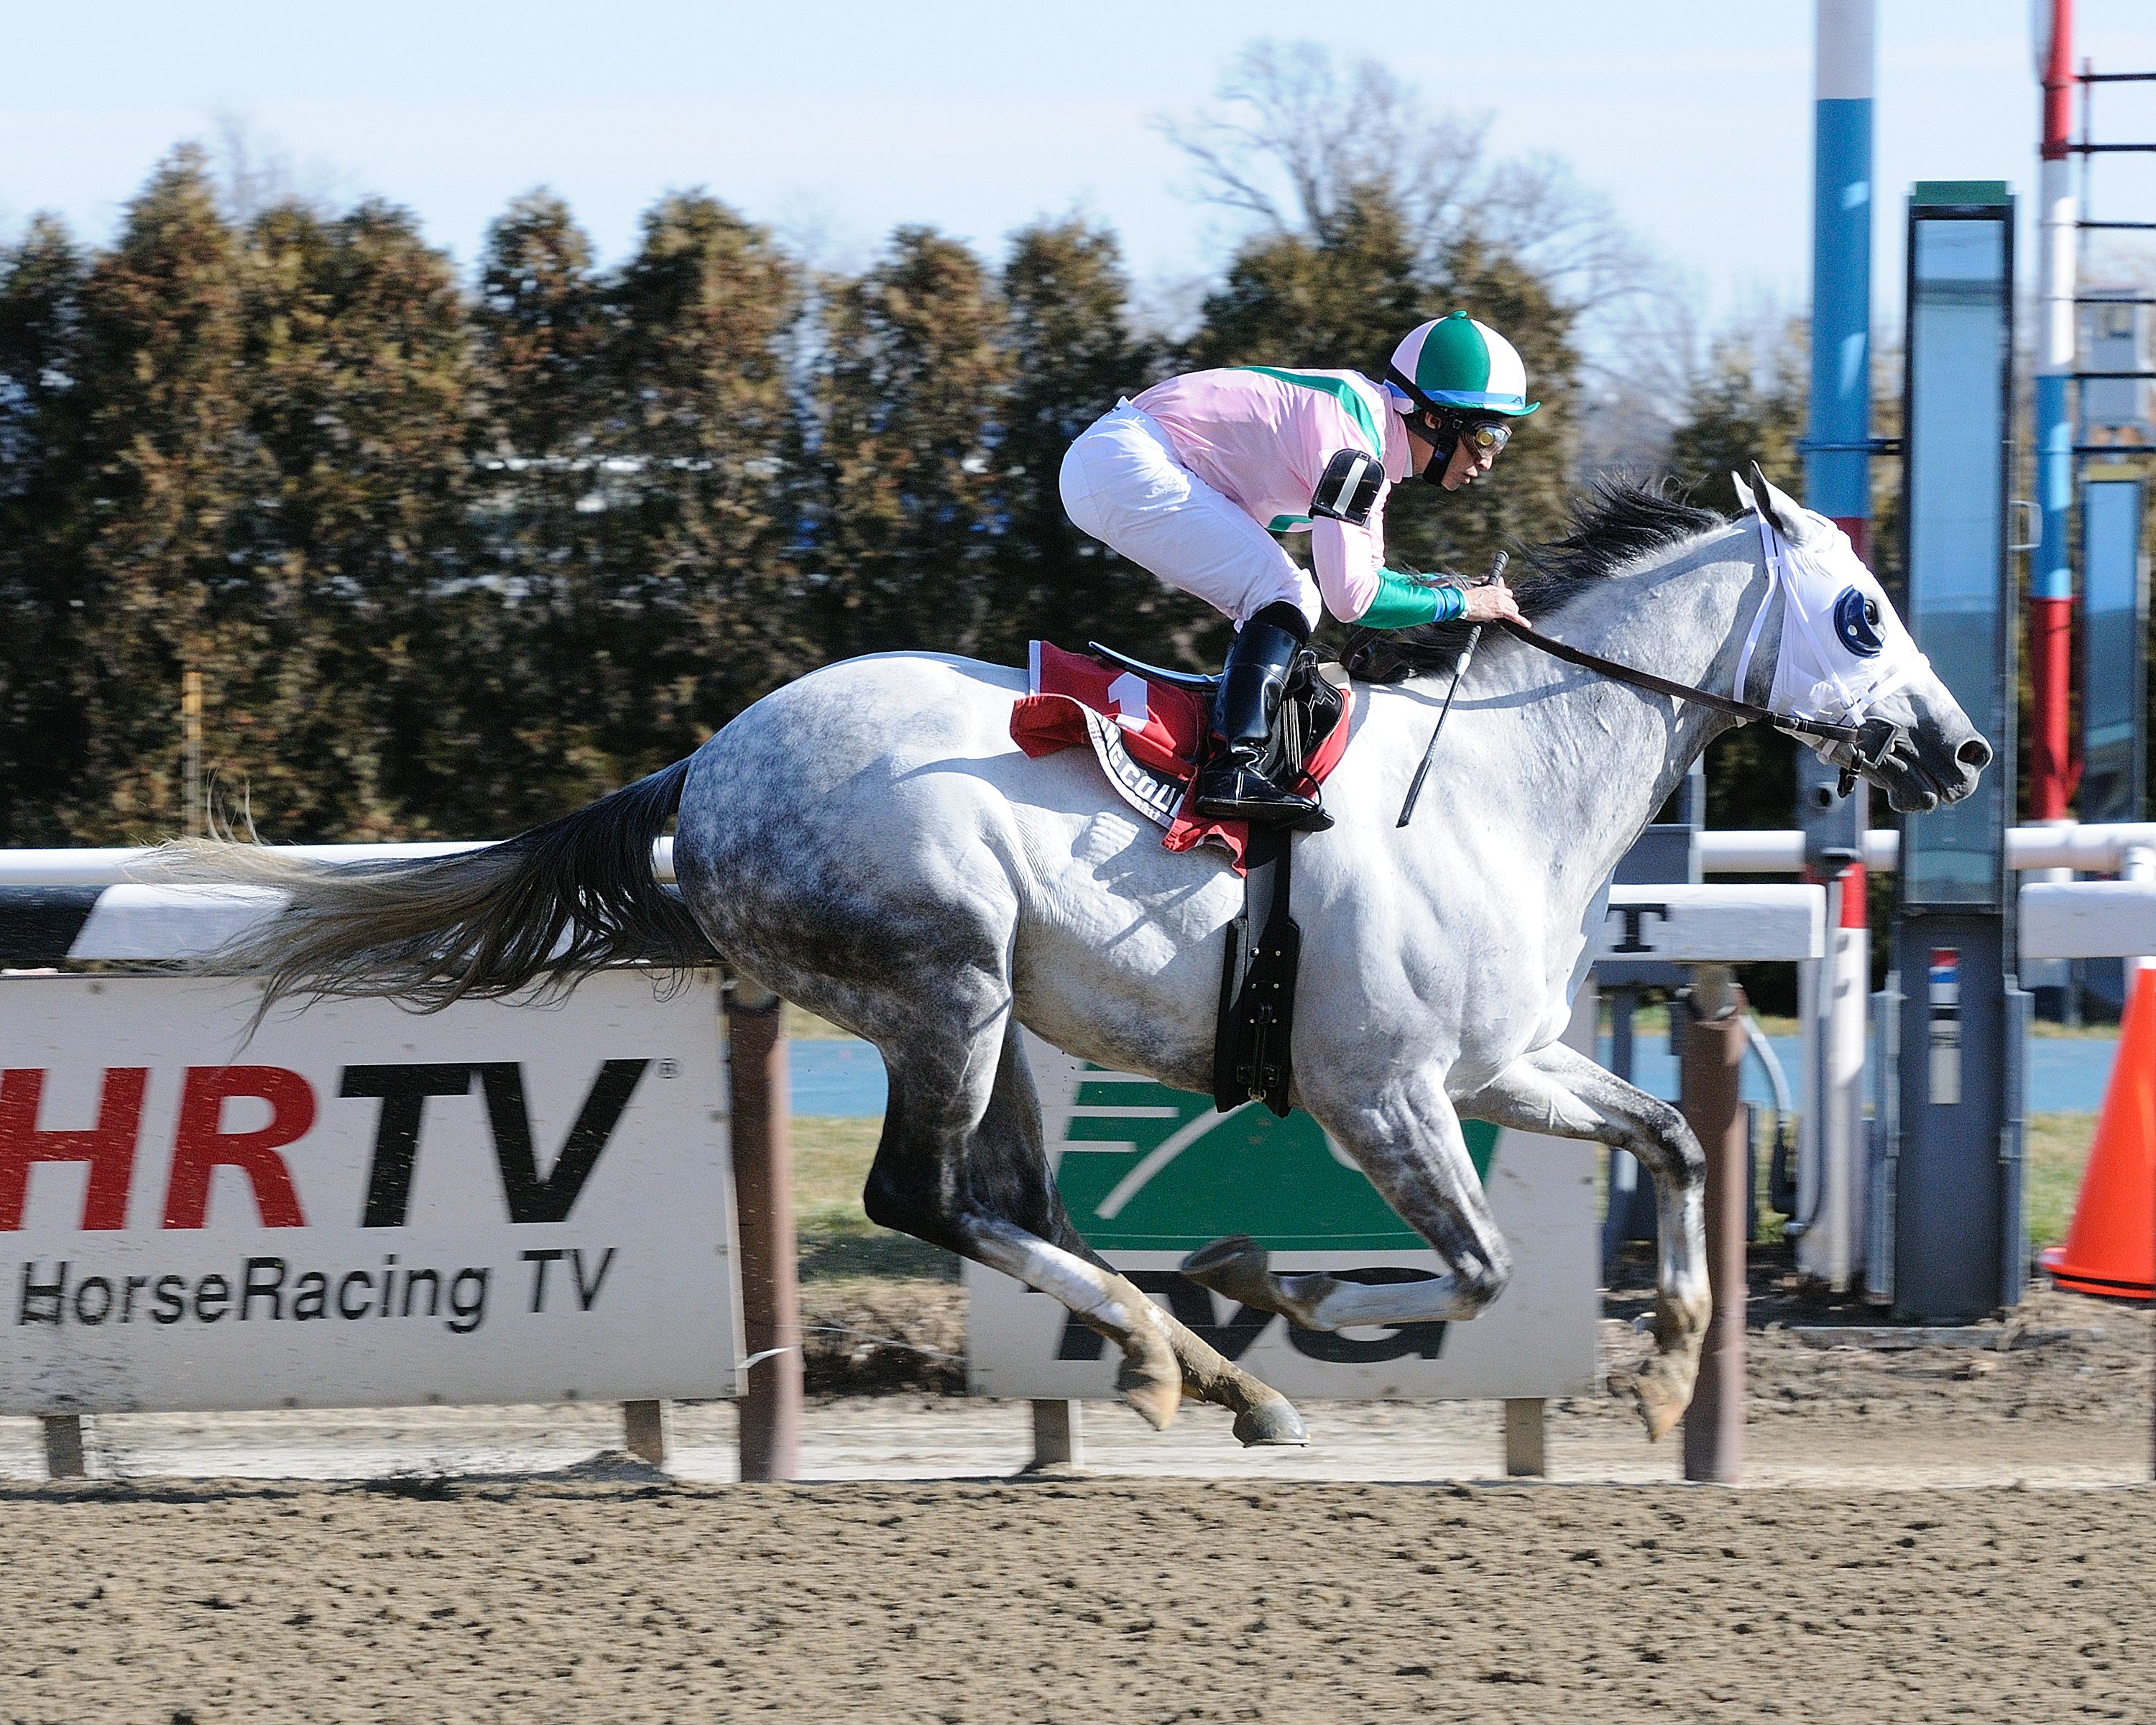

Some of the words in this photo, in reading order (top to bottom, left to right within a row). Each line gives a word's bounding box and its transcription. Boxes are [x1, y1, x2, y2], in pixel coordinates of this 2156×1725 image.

[1107, 671, 1150, 733] 1
[0, 1057, 654, 1231] HRTV
[18, 1254, 492, 1334] HorseRacing
[518, 1247, 617, 1312] TV
